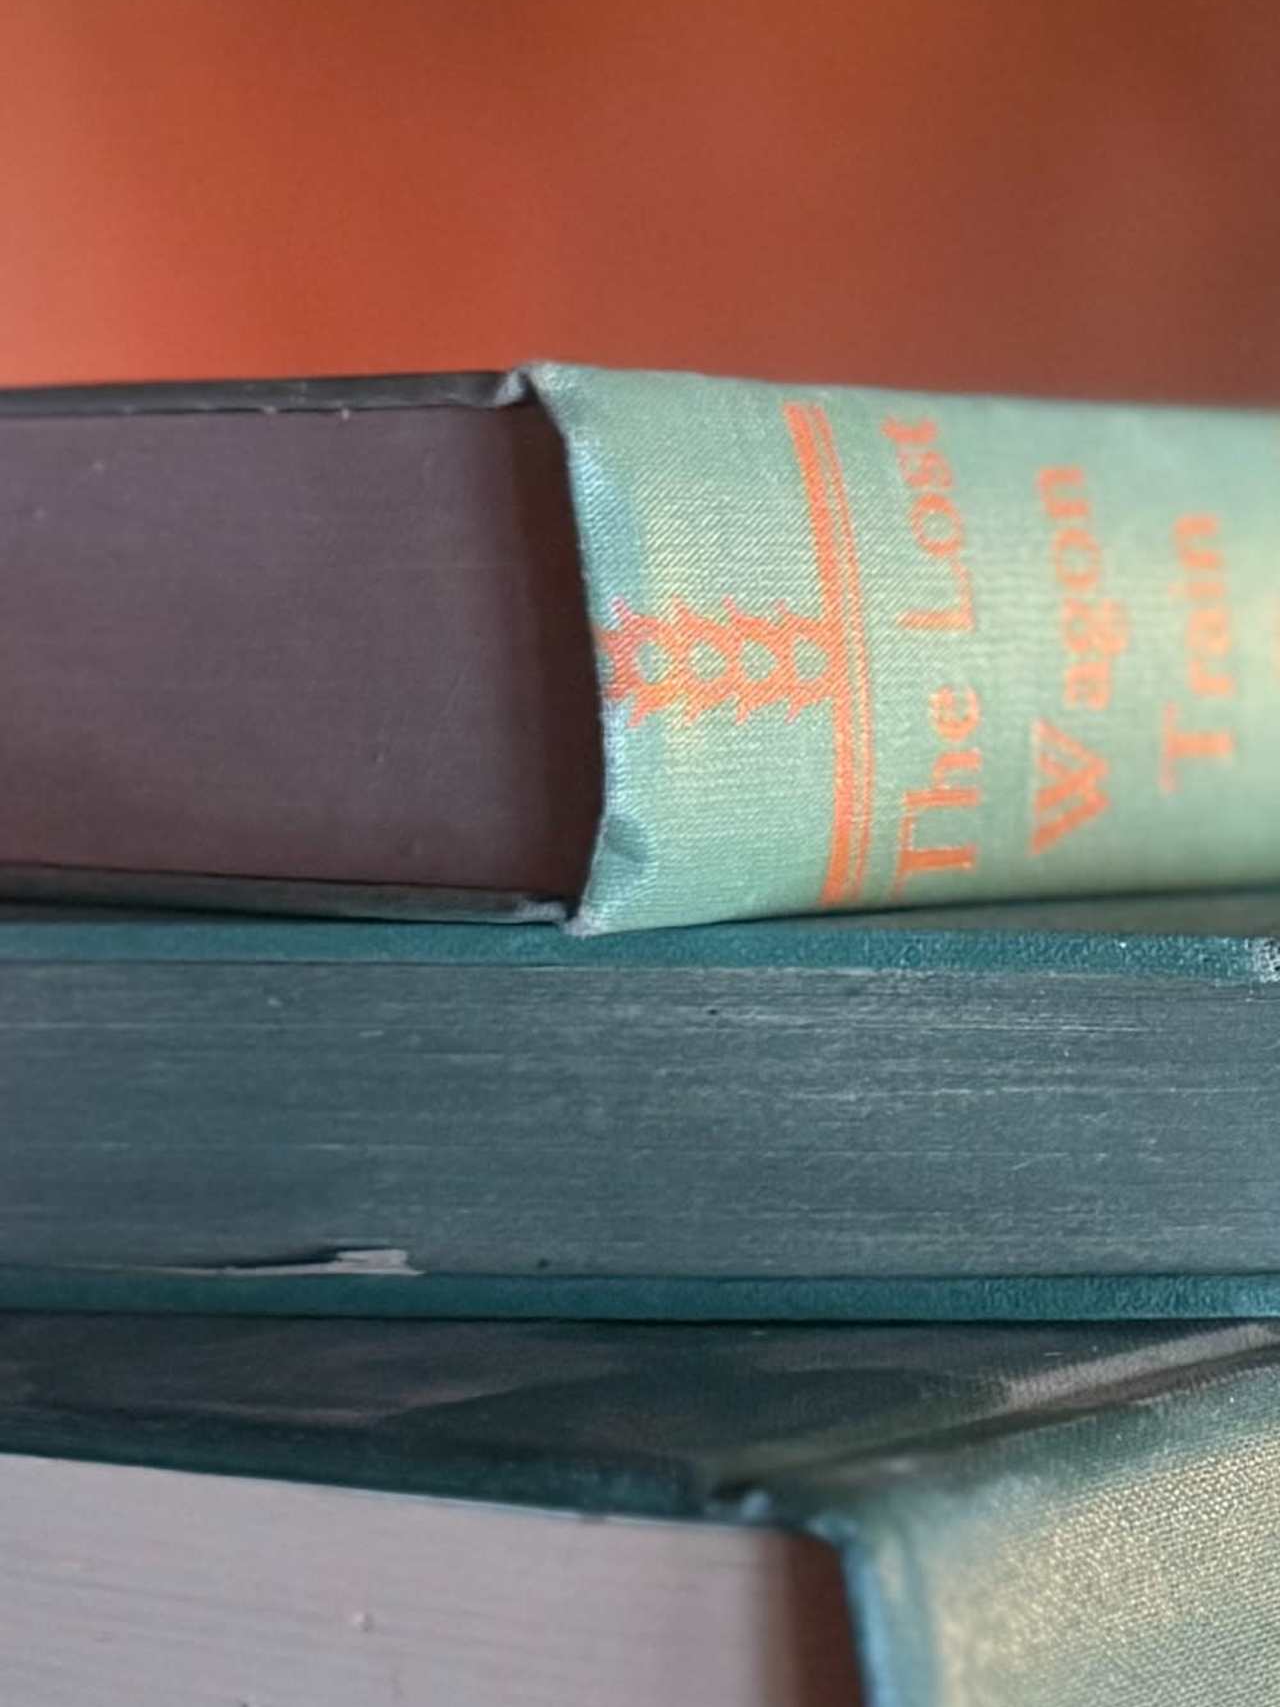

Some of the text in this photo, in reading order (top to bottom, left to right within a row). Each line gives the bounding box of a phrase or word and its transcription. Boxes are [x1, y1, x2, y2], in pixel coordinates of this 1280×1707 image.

[882, 415, 982, 896] The Lost
[1027, 464, 1130, 857] Wagon
[1159, 512, 1235, 796] Train
